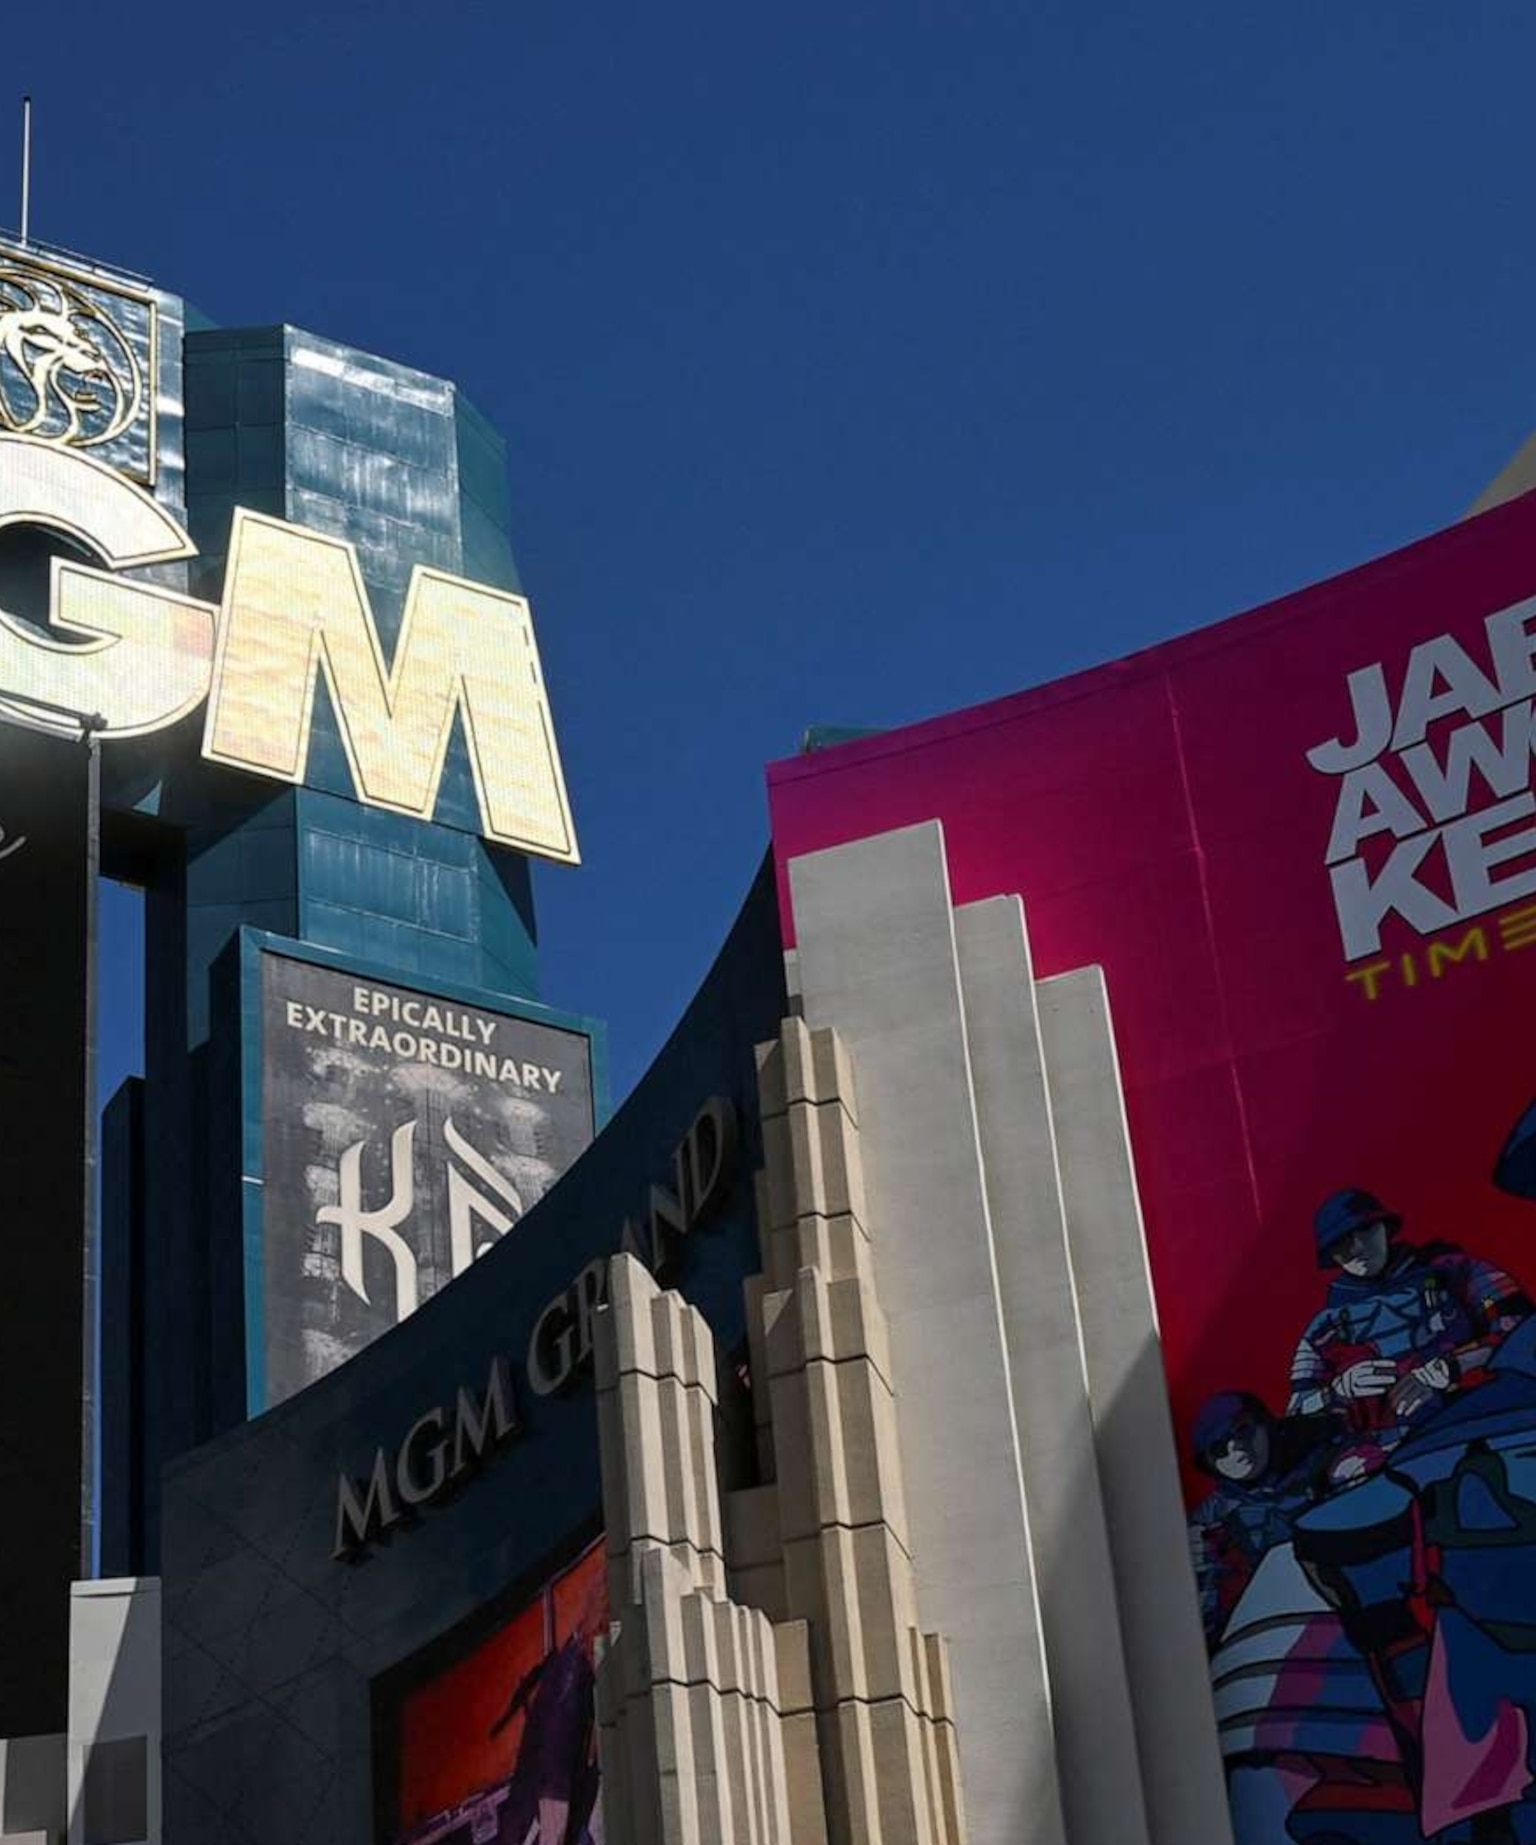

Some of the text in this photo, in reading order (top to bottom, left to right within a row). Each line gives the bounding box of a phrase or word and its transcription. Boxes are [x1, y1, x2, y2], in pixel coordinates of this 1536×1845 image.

[1325, 698, 1536, 865] AW
[286, 1001, 562, 1094] EXTRAORDINARY
[354, 986, 496, 1045] EPICALLY
[329, 1355, 522, 1562] MGM
